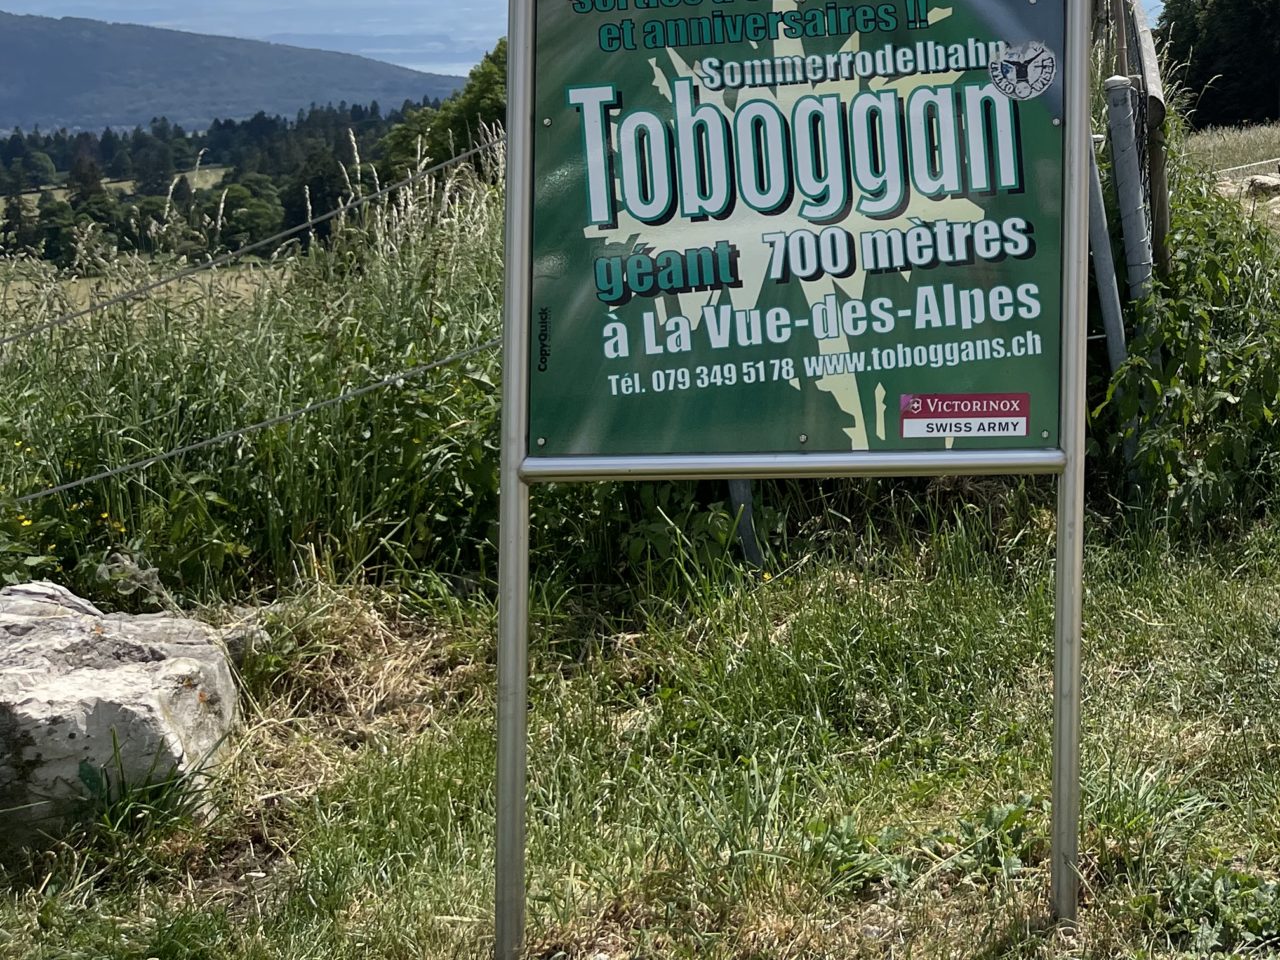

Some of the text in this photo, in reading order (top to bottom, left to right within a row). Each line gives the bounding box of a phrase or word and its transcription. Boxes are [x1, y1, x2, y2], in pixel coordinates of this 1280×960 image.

[599, 18, 637, 52] et
[643, 2, 897, 49] anniversaires
[701, 37, 1008, 91] Sommerrodelbahn
[567, 76, 1030, 230] Toboggan
[595, 215, 1036, 304] géant 700 mètres
[537, 306, 550, 373] CopyQuick
[602, 311, 630, 359] à
[642, 310, 692, 355] La
[701, 281, 1042, 349] Vue-des-Alpes
[607, 330, 1042, 396] Tél. 079 349 51 78 www.toboggans.ch
[925, 421, 1020, 433] SWISS ARMY
